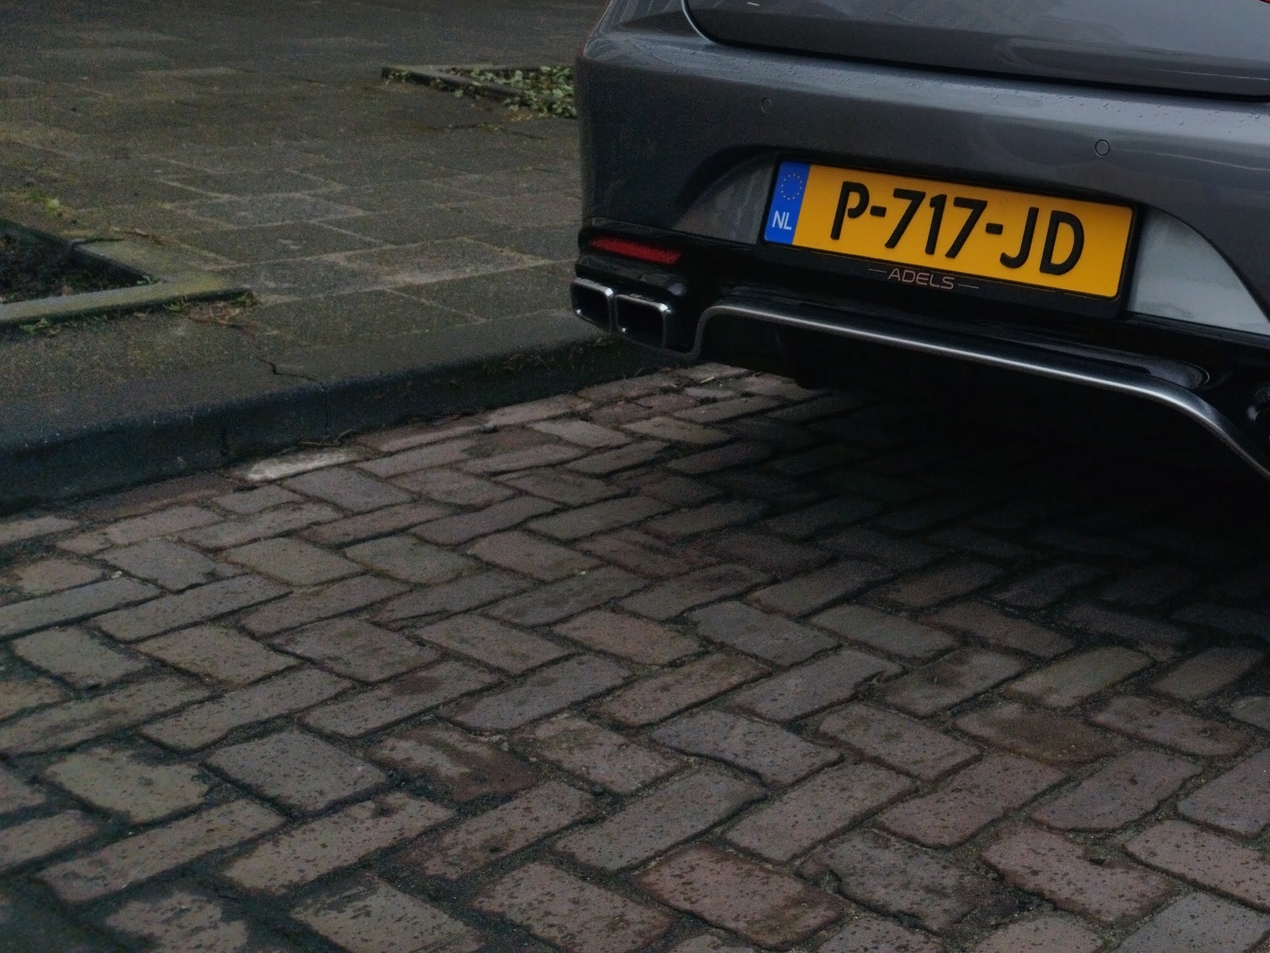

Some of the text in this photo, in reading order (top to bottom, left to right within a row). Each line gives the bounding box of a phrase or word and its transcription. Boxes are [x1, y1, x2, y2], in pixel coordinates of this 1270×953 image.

[772, 211, 793, 231] NL
[830, 181, 1085, 276] P-717-JD
[887, 268, 956, 290] ADELS
